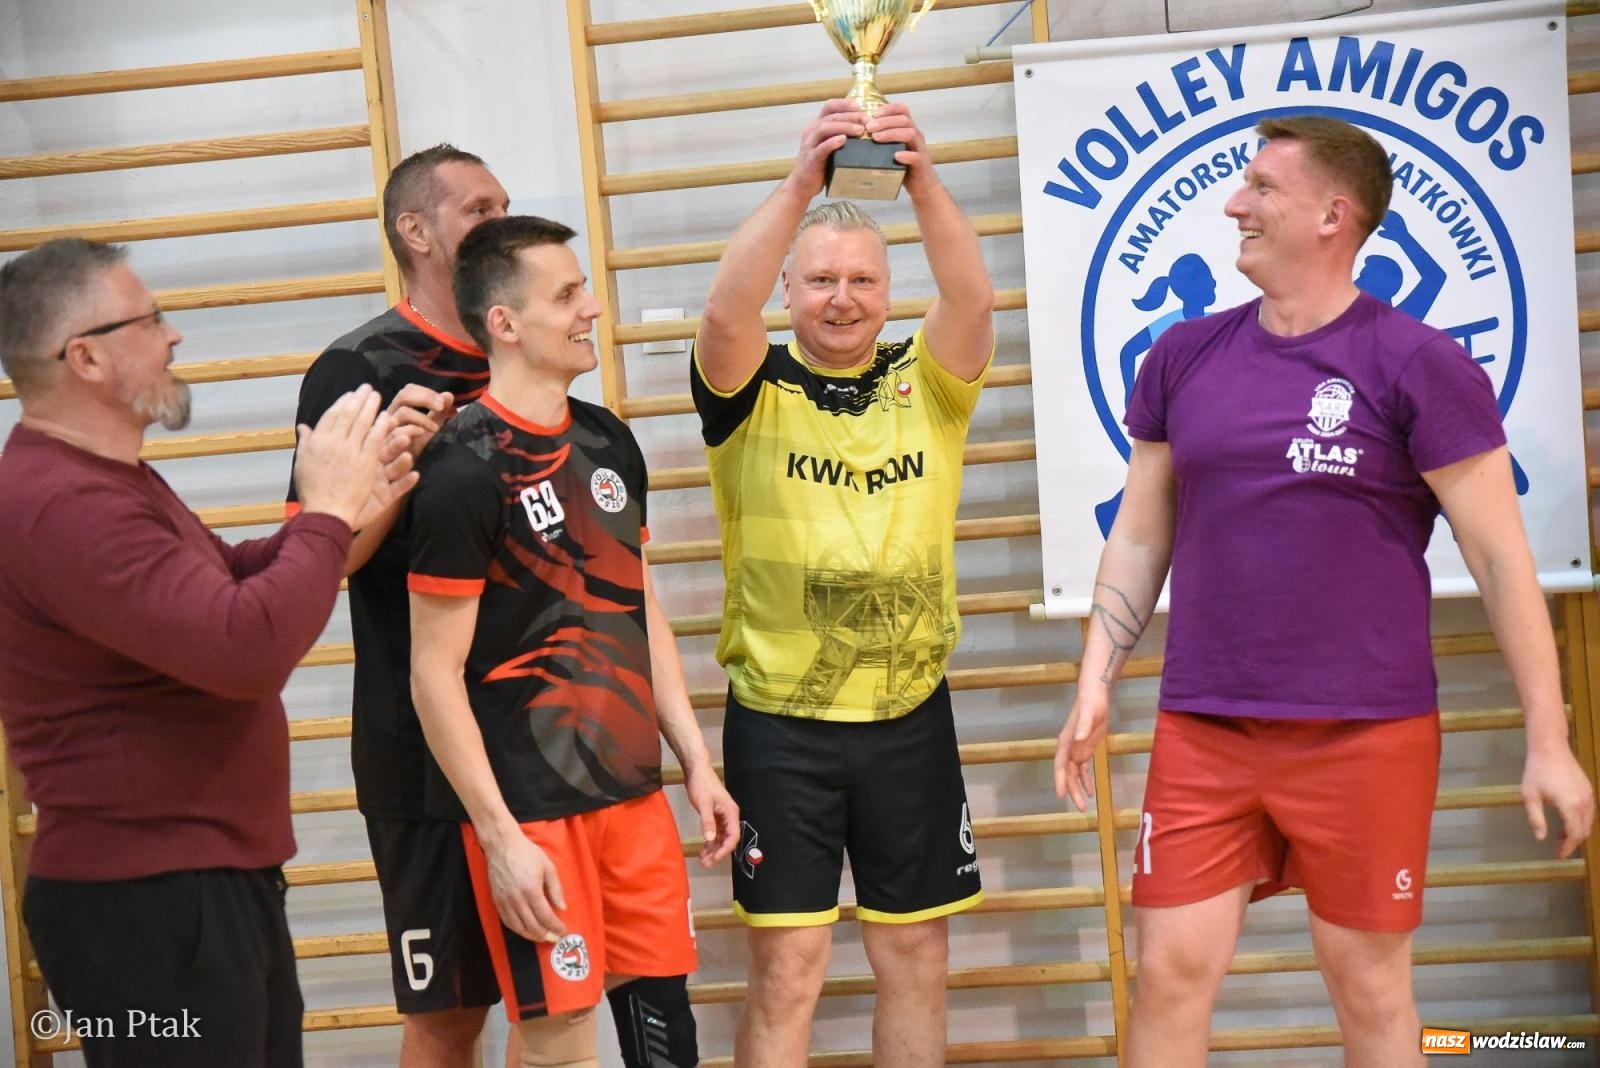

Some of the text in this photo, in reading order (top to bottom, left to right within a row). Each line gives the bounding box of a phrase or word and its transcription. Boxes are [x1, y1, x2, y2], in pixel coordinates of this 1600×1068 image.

[1043, 36, 1545, 210] VOLLEY AMIGOS
[1388, 152, 1497, 281] IATKÓWKI
[865, 450, 924, 495] ROW
[1286, 441, 1358, 465] ATLAS
[519, 479, 566, 533] 69
[956, 860, 978, 876] reg
[400, 928, 434, 991] 6
